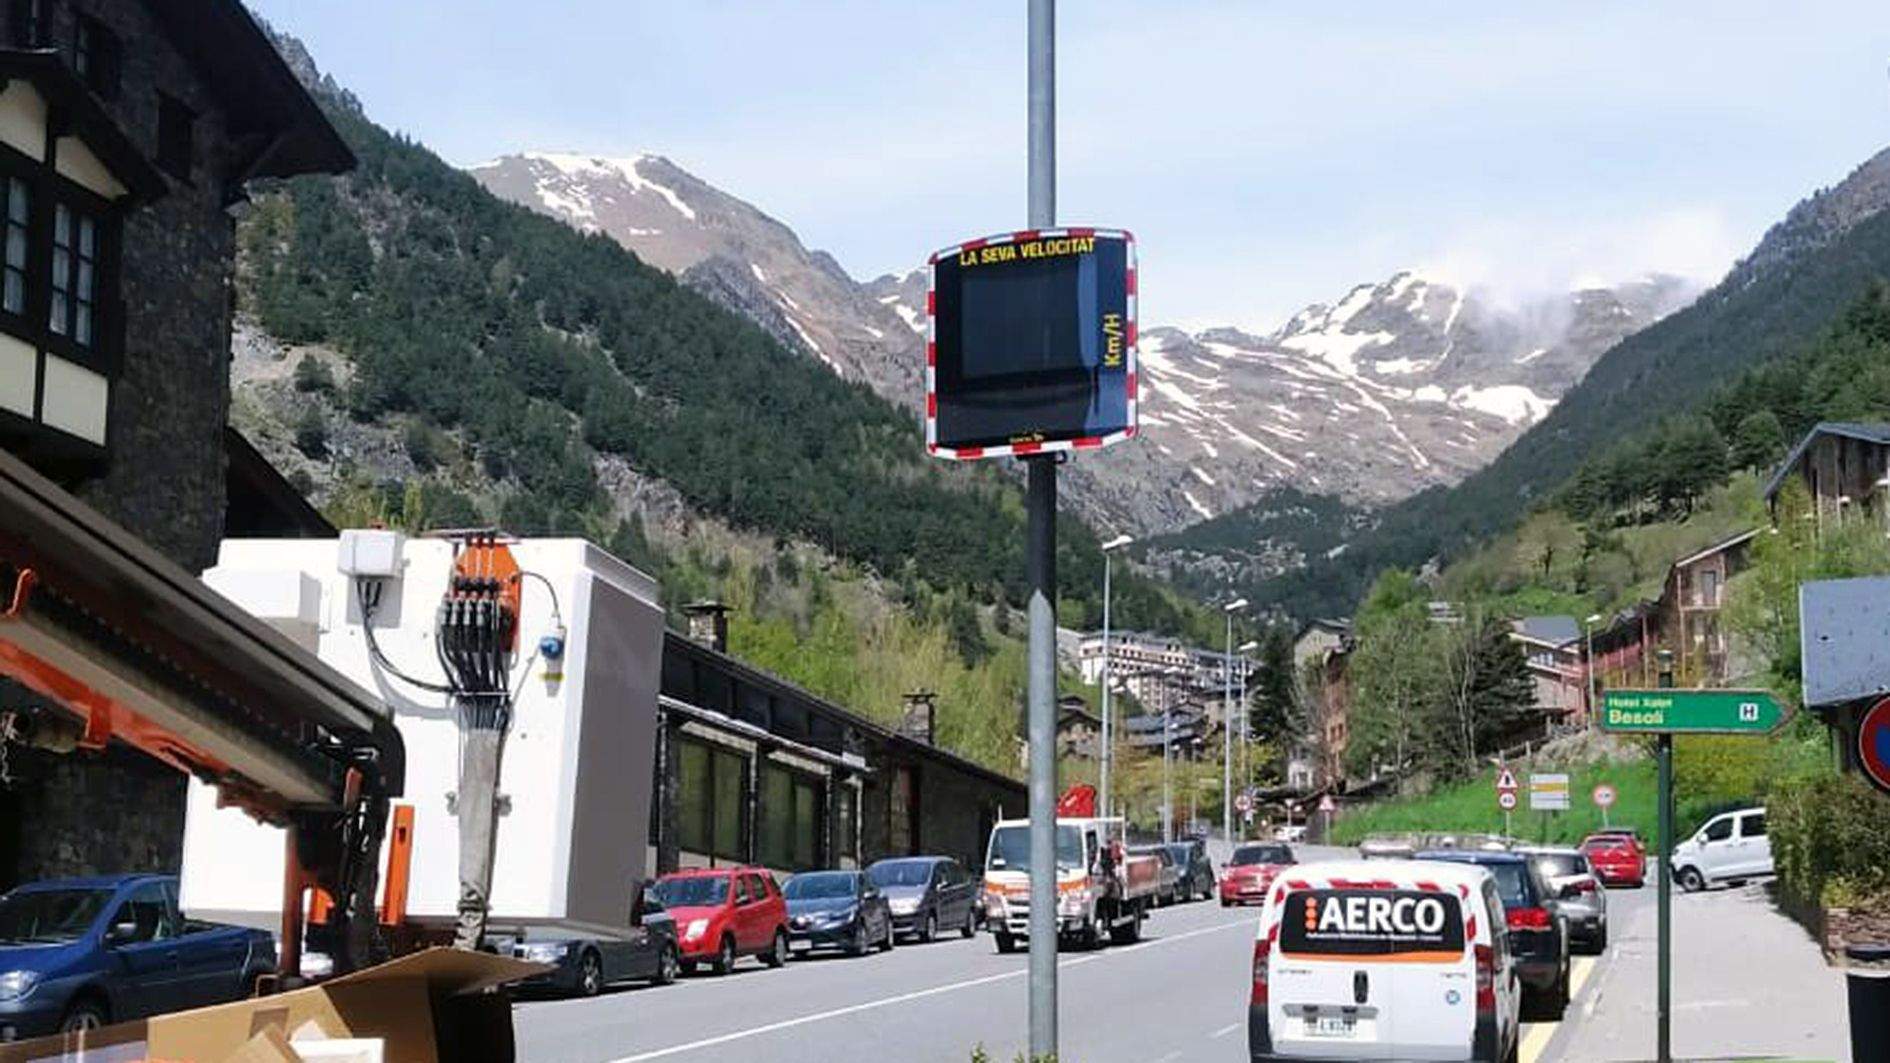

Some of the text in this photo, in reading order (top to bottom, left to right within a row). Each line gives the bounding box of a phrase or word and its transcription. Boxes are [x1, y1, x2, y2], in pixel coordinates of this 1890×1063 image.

[959, 237, 1096, 266] LA SEVA VELOCITAT
[1743, 705, 1755, 718] H
[1318, 897, 1445, 933] AERCO
